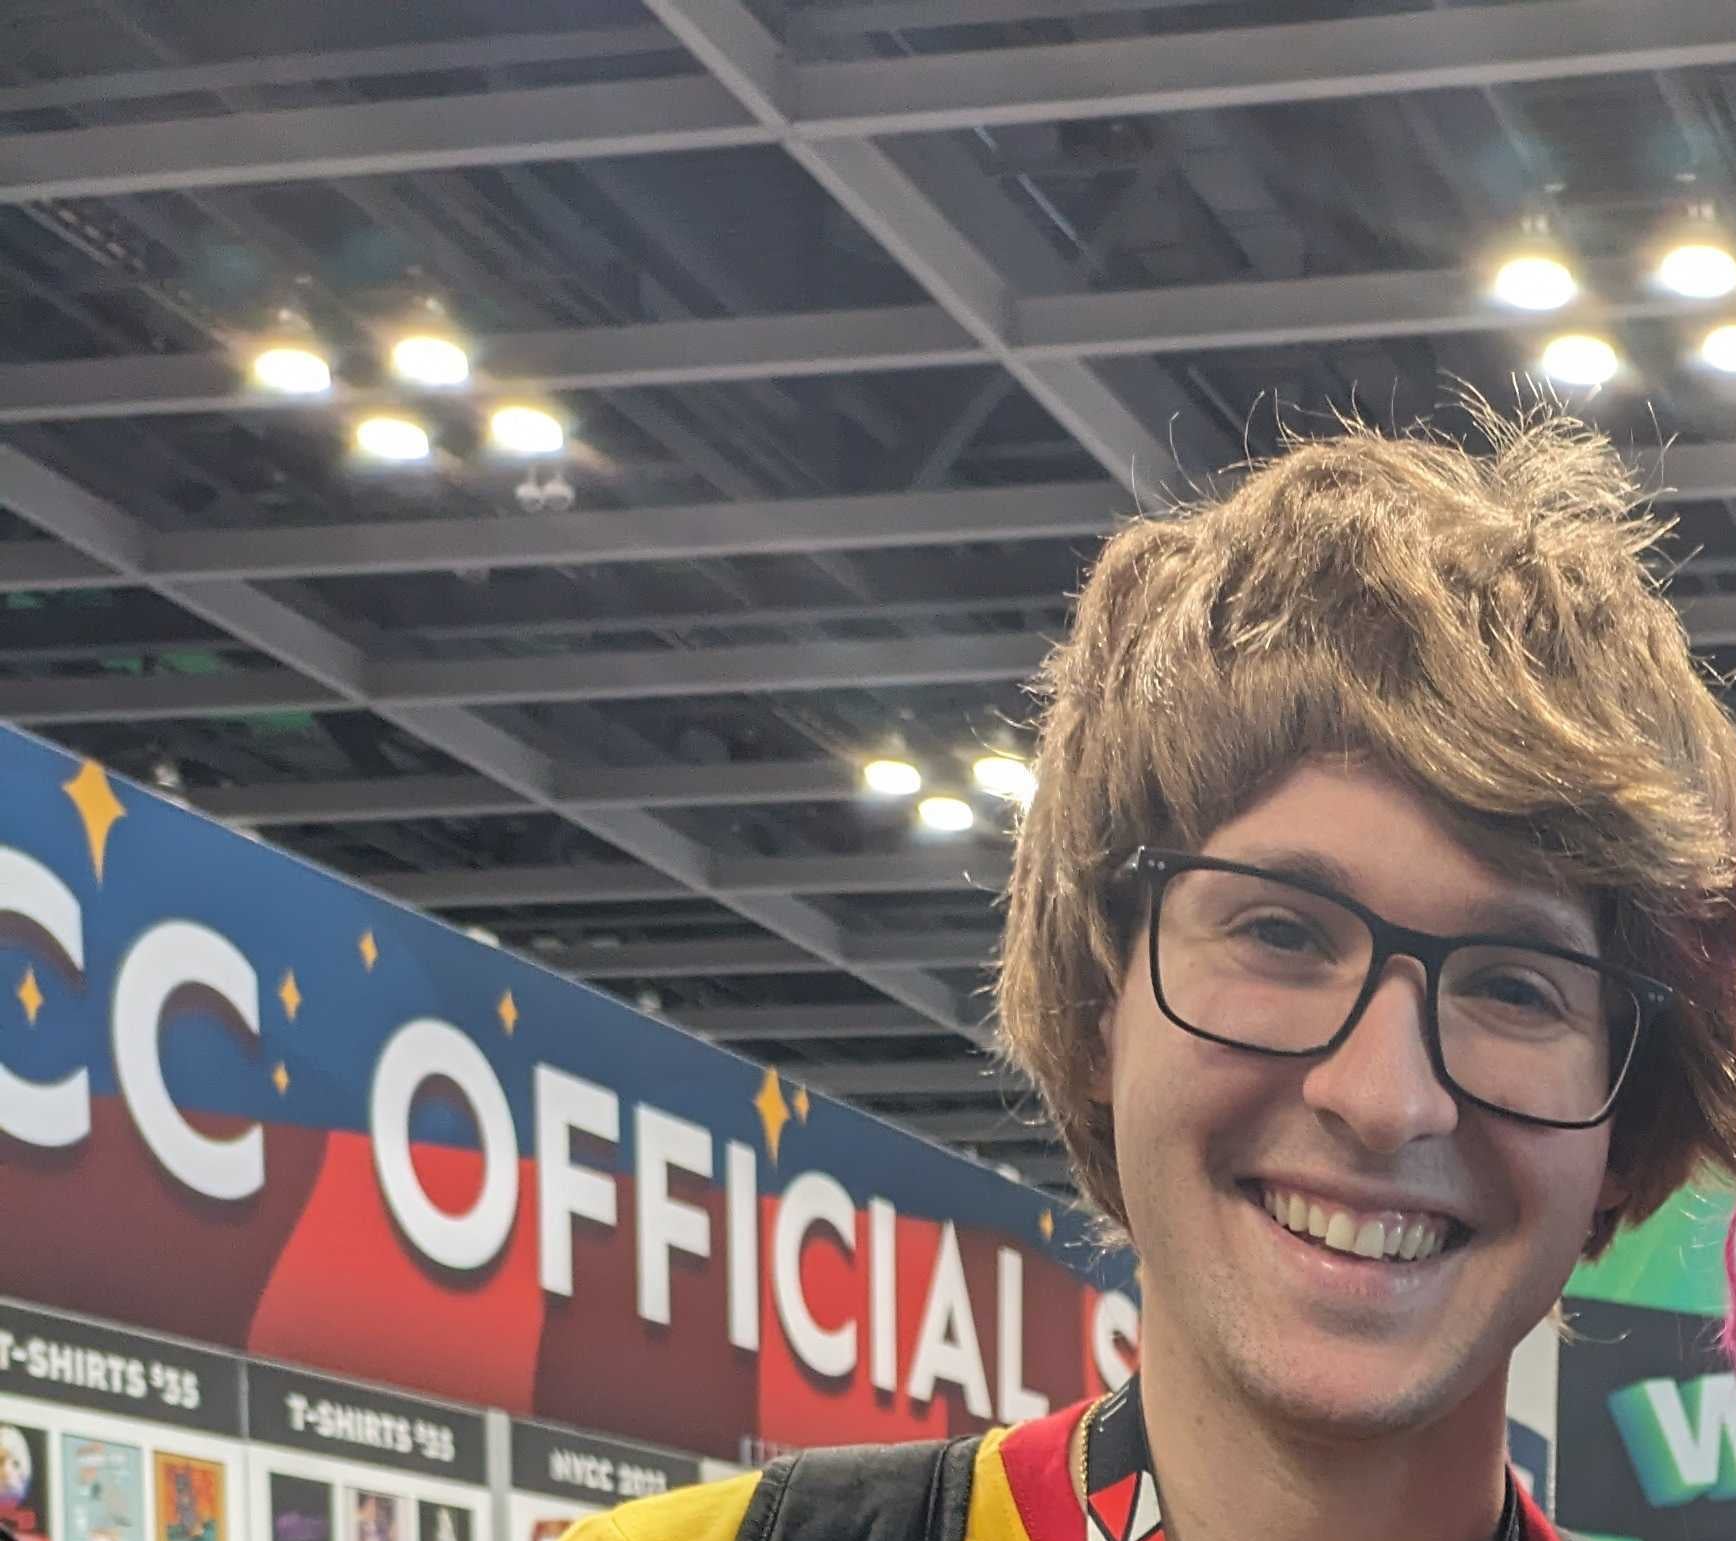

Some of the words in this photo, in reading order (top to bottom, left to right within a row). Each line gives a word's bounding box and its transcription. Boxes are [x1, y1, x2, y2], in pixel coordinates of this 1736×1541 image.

[370, 1017, 1050, 1424] OFFICIAL
[287, 1394, 413, 1454] T-SHIRTS
[549, 1448, 615, 1493] NYCC
